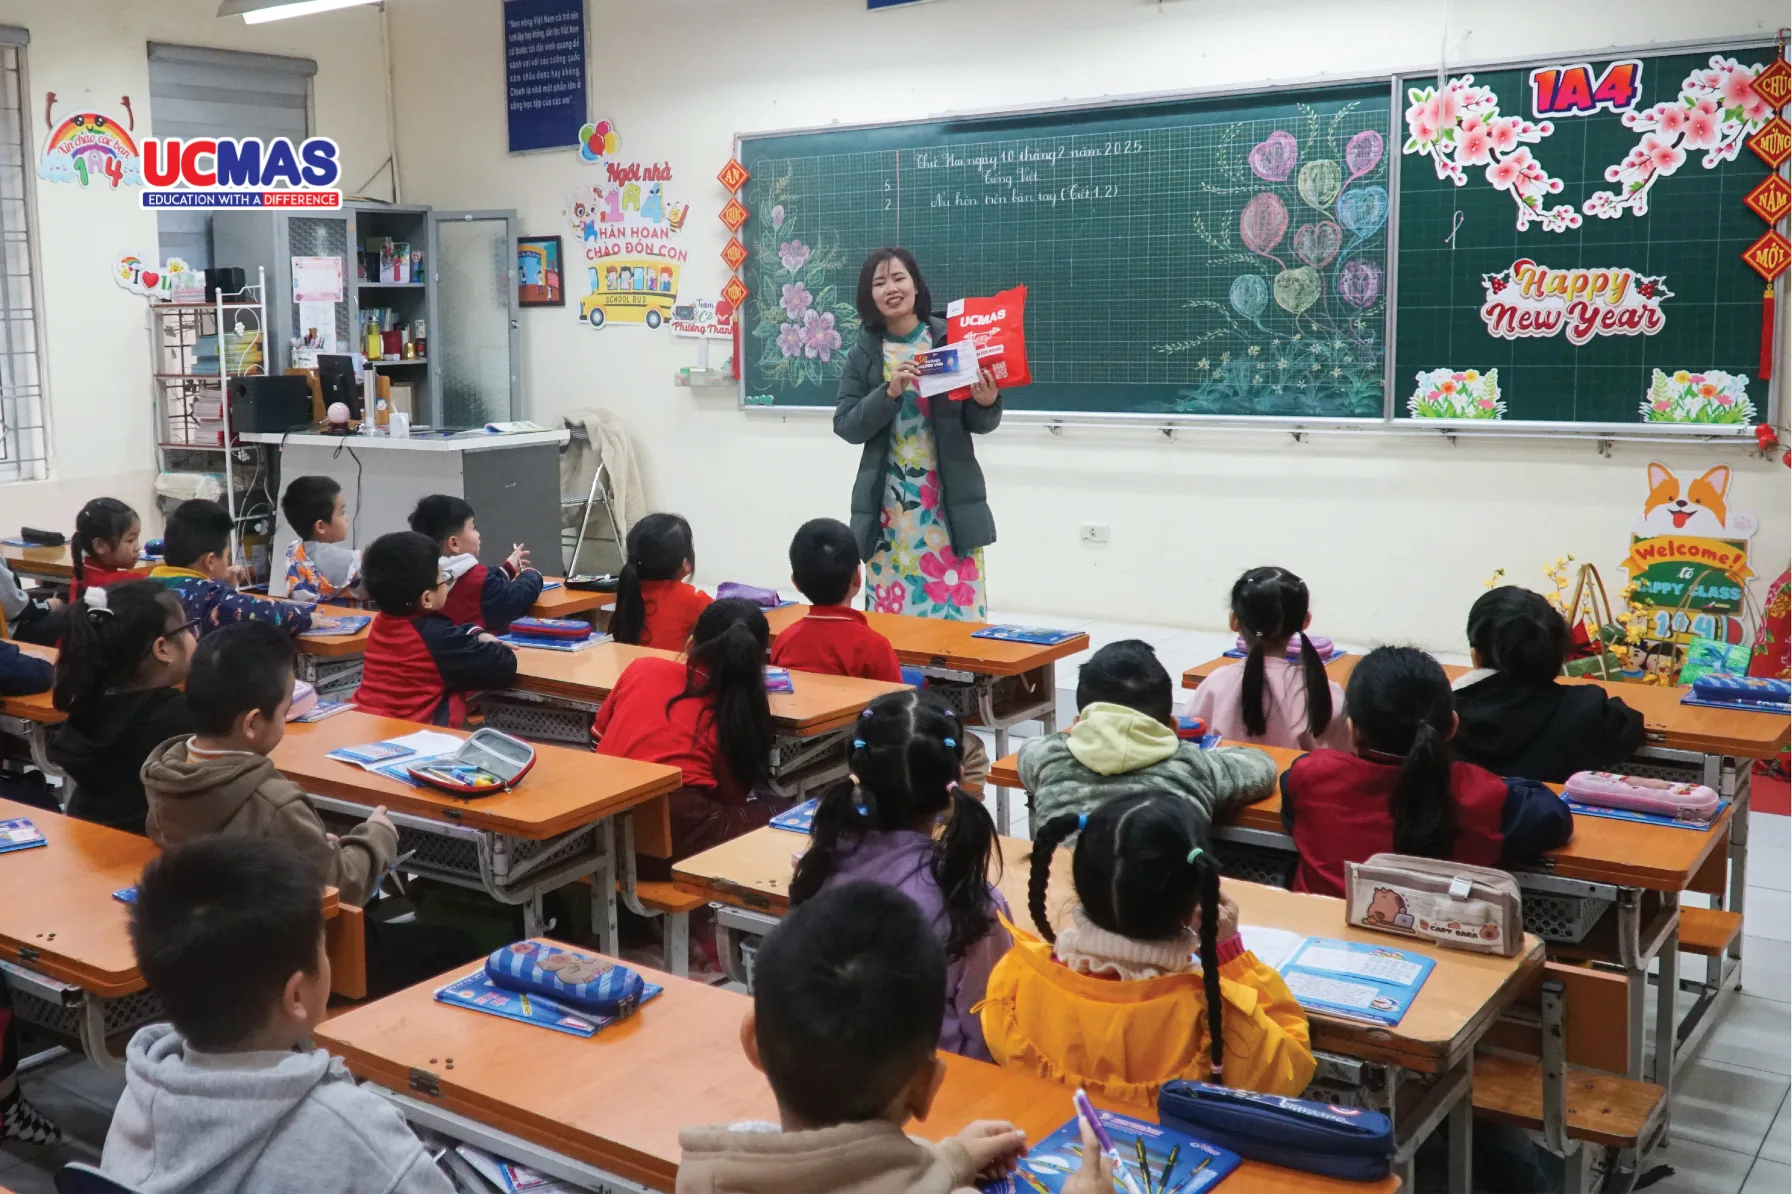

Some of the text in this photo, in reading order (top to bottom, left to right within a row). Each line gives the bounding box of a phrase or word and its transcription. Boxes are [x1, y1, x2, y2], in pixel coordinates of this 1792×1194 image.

[1533, 63, 1638, 114] 1A4
[1000, 150, 1014, 163] 10
[1058, 146, 1065, 159] 2
[1070, 146, 1102, 158] năm
[1104, 140, 1143, 155] 2025
[74, 150, 124, 188] 1A4
[606, 161, 673, 187] Ngôi nhà
[884, 181, 891, 191] 5
[604, 182, 664, 223] 1A4
[885, 200, 891, 209] 2
[1038, 191, 1056, 207] tay
[599, 224, 670, 240] HÂN HOAN
[586, 238, 688, 262] CHÀO ĐÓN CON
[1517, 267, 1630, 304] Happy
[606, 295, 647, 304] SCHOOL BUS
[960, 309, 1006, 328] UCMAS
[1486, 300, 1660, 338] New Year
[1634, 540, 1743, 569] Welcome!
[1676, 566, 1695, 580] to
